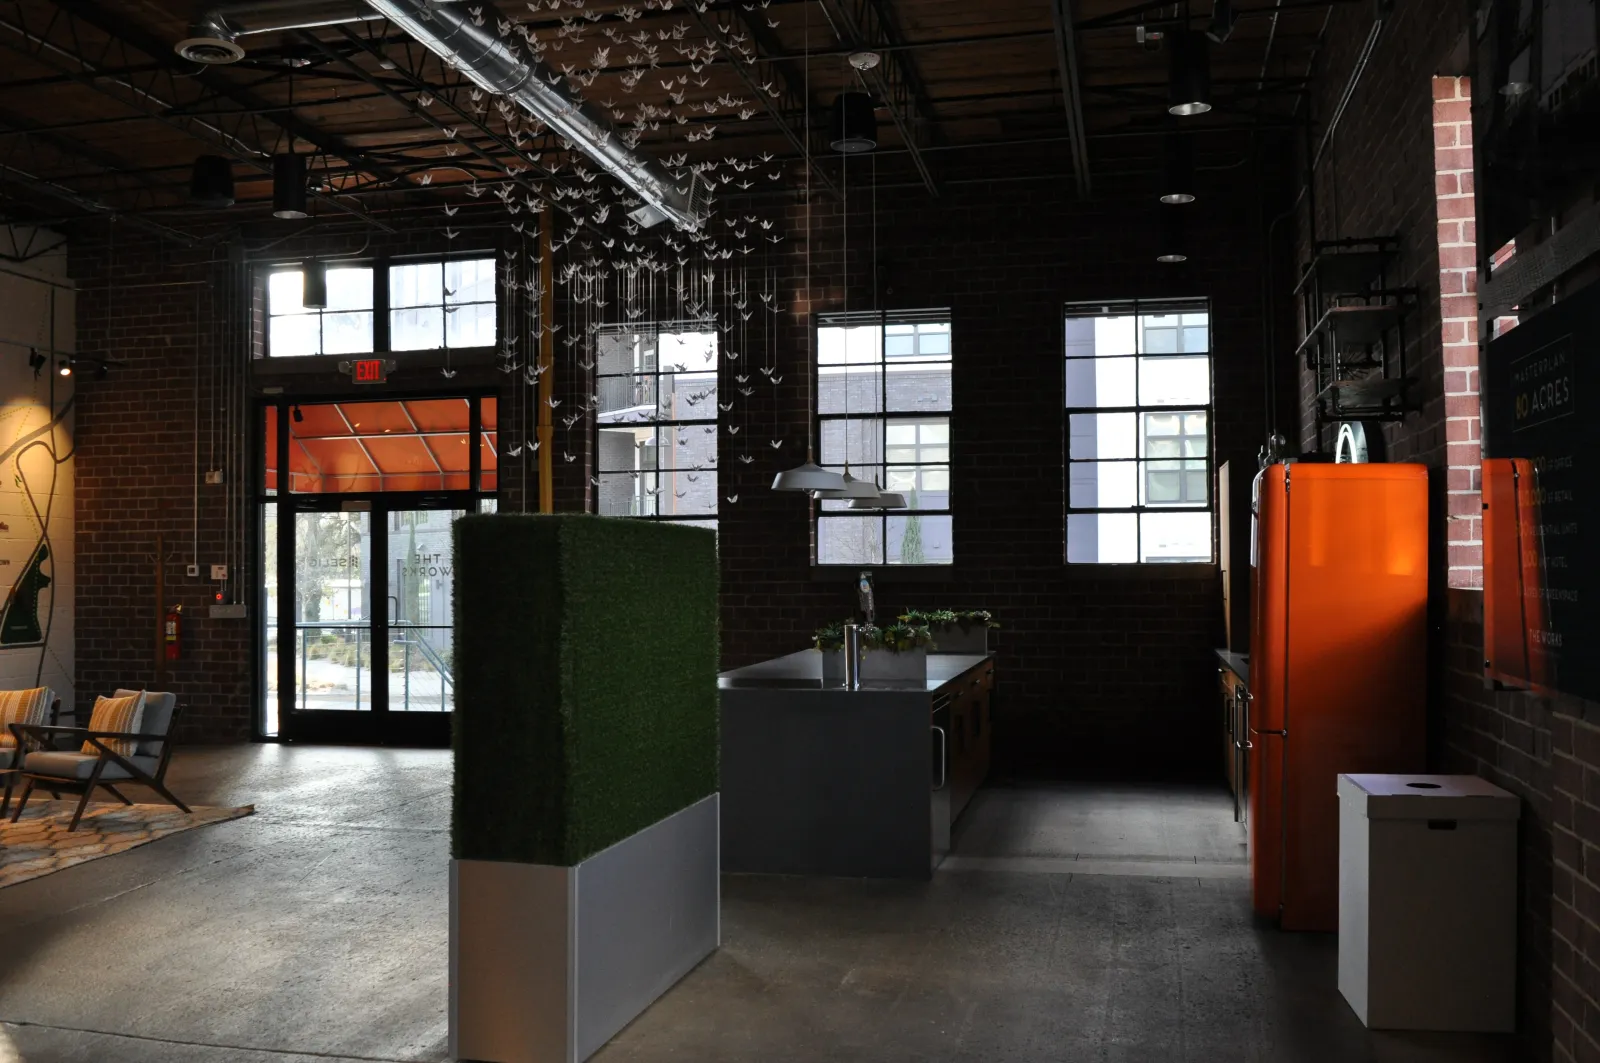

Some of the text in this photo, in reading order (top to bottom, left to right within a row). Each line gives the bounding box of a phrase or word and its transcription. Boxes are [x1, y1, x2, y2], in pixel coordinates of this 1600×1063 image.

[356, 361, 381, 381] EXIT
[1532, 376, 1569, 414] ACRES
[1555, 489, 1573, 502] RETAIL
[1529, 628, 1562, 647] THE WORKS
